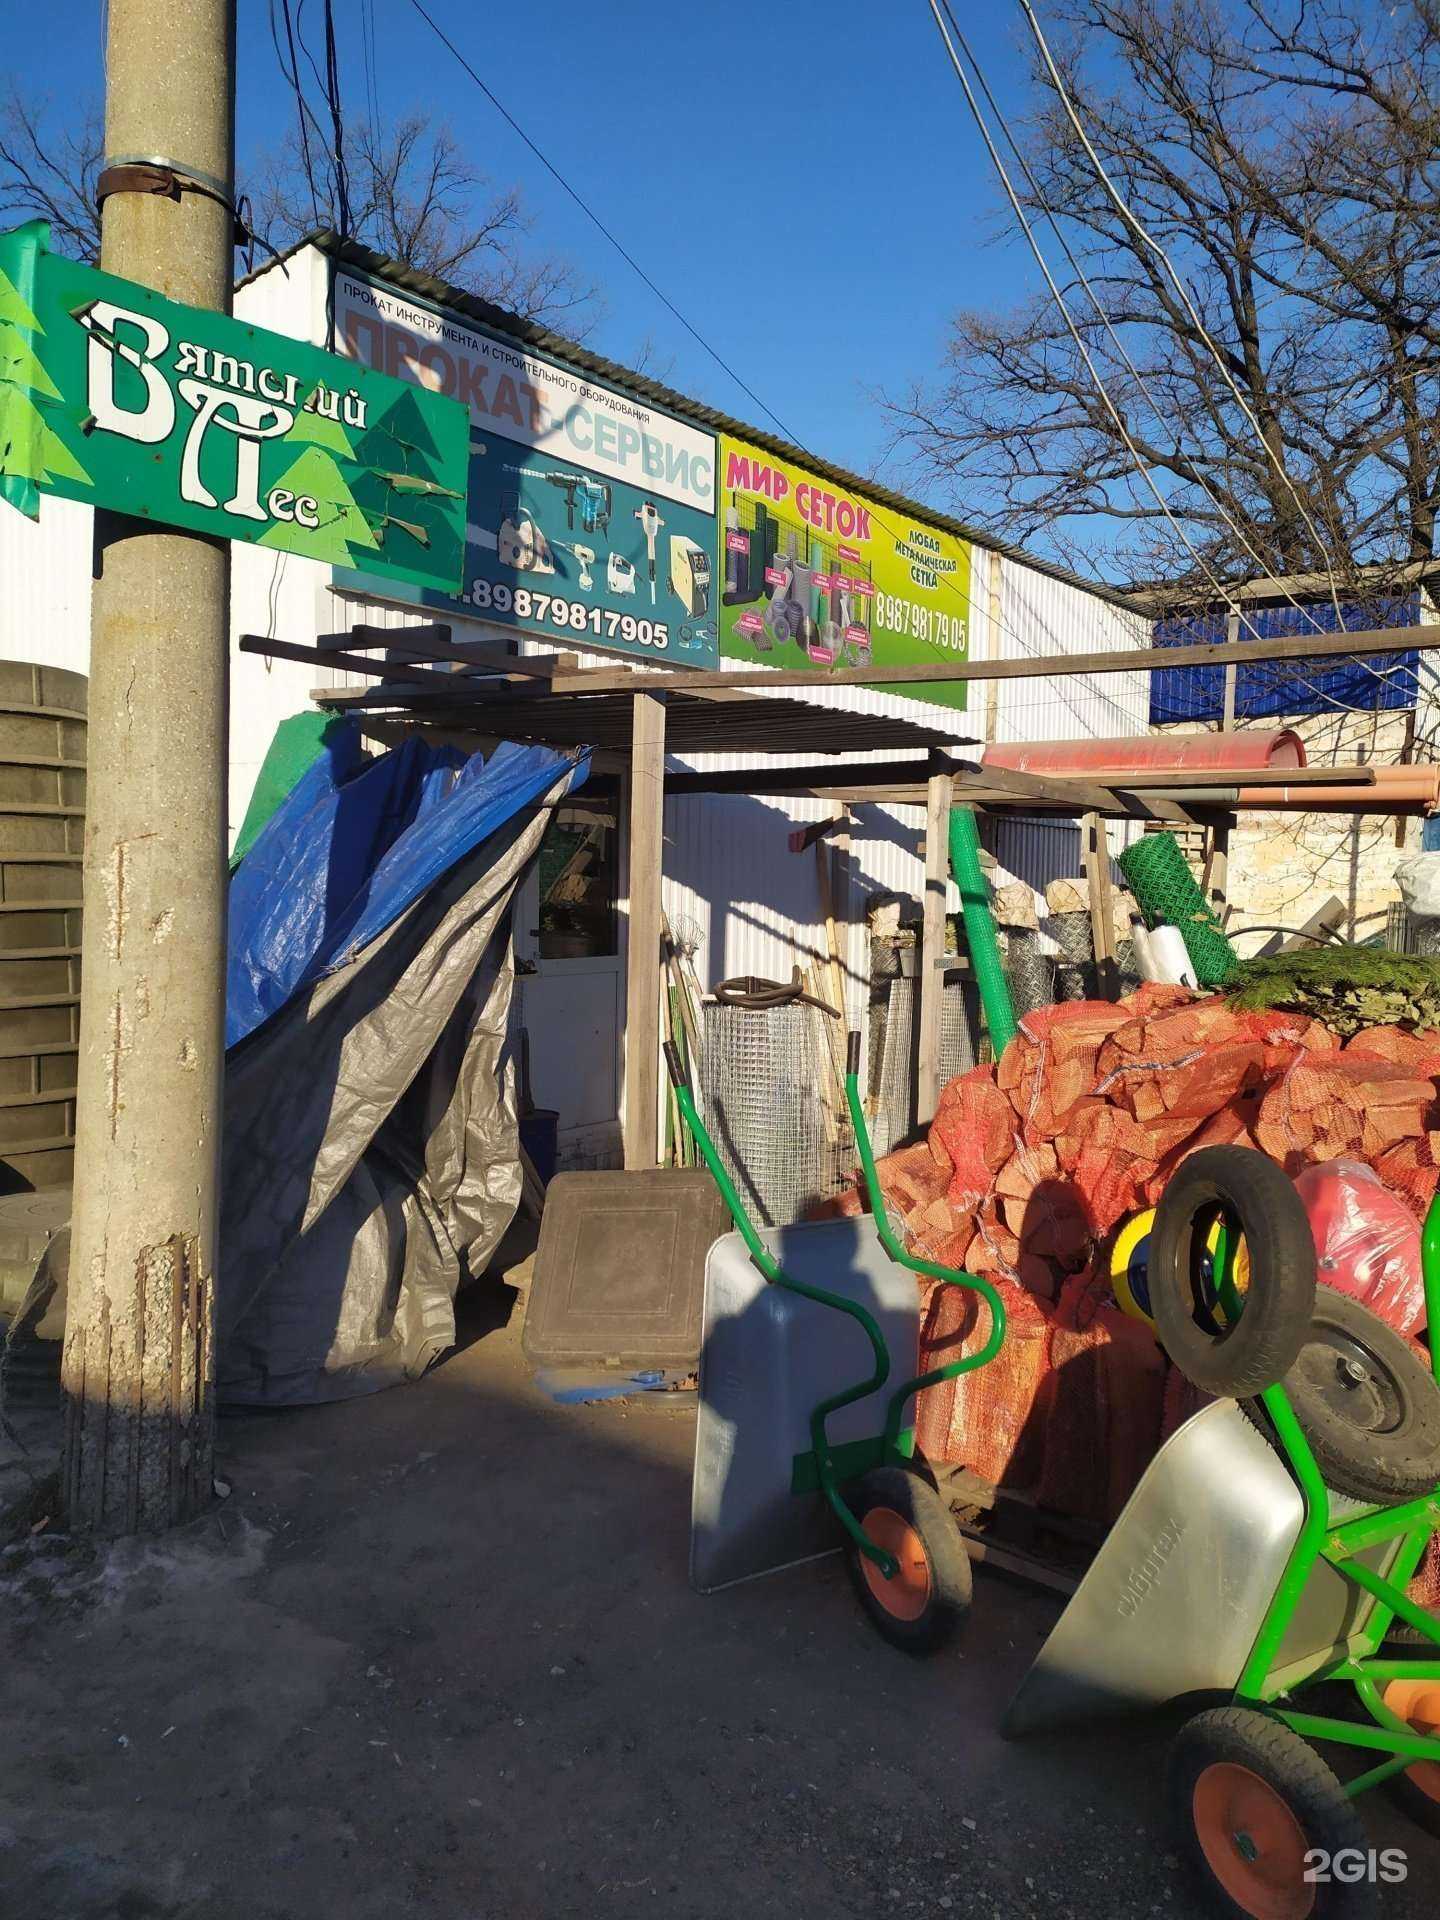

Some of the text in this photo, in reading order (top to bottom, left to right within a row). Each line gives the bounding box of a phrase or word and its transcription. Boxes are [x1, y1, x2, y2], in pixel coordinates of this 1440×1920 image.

[344, 282, 651, 425] ПРОКАТ ИНСТРУМЕНТА И СТРОИТЕЛЬНОГО ОБОРУДОВАНИЯ
[726, 452, 871, 540] МИР СЕТОК
[909, 530, 940, 554] ЛЮБАЯ
[910, 565, 938, 588] СЕТКА
